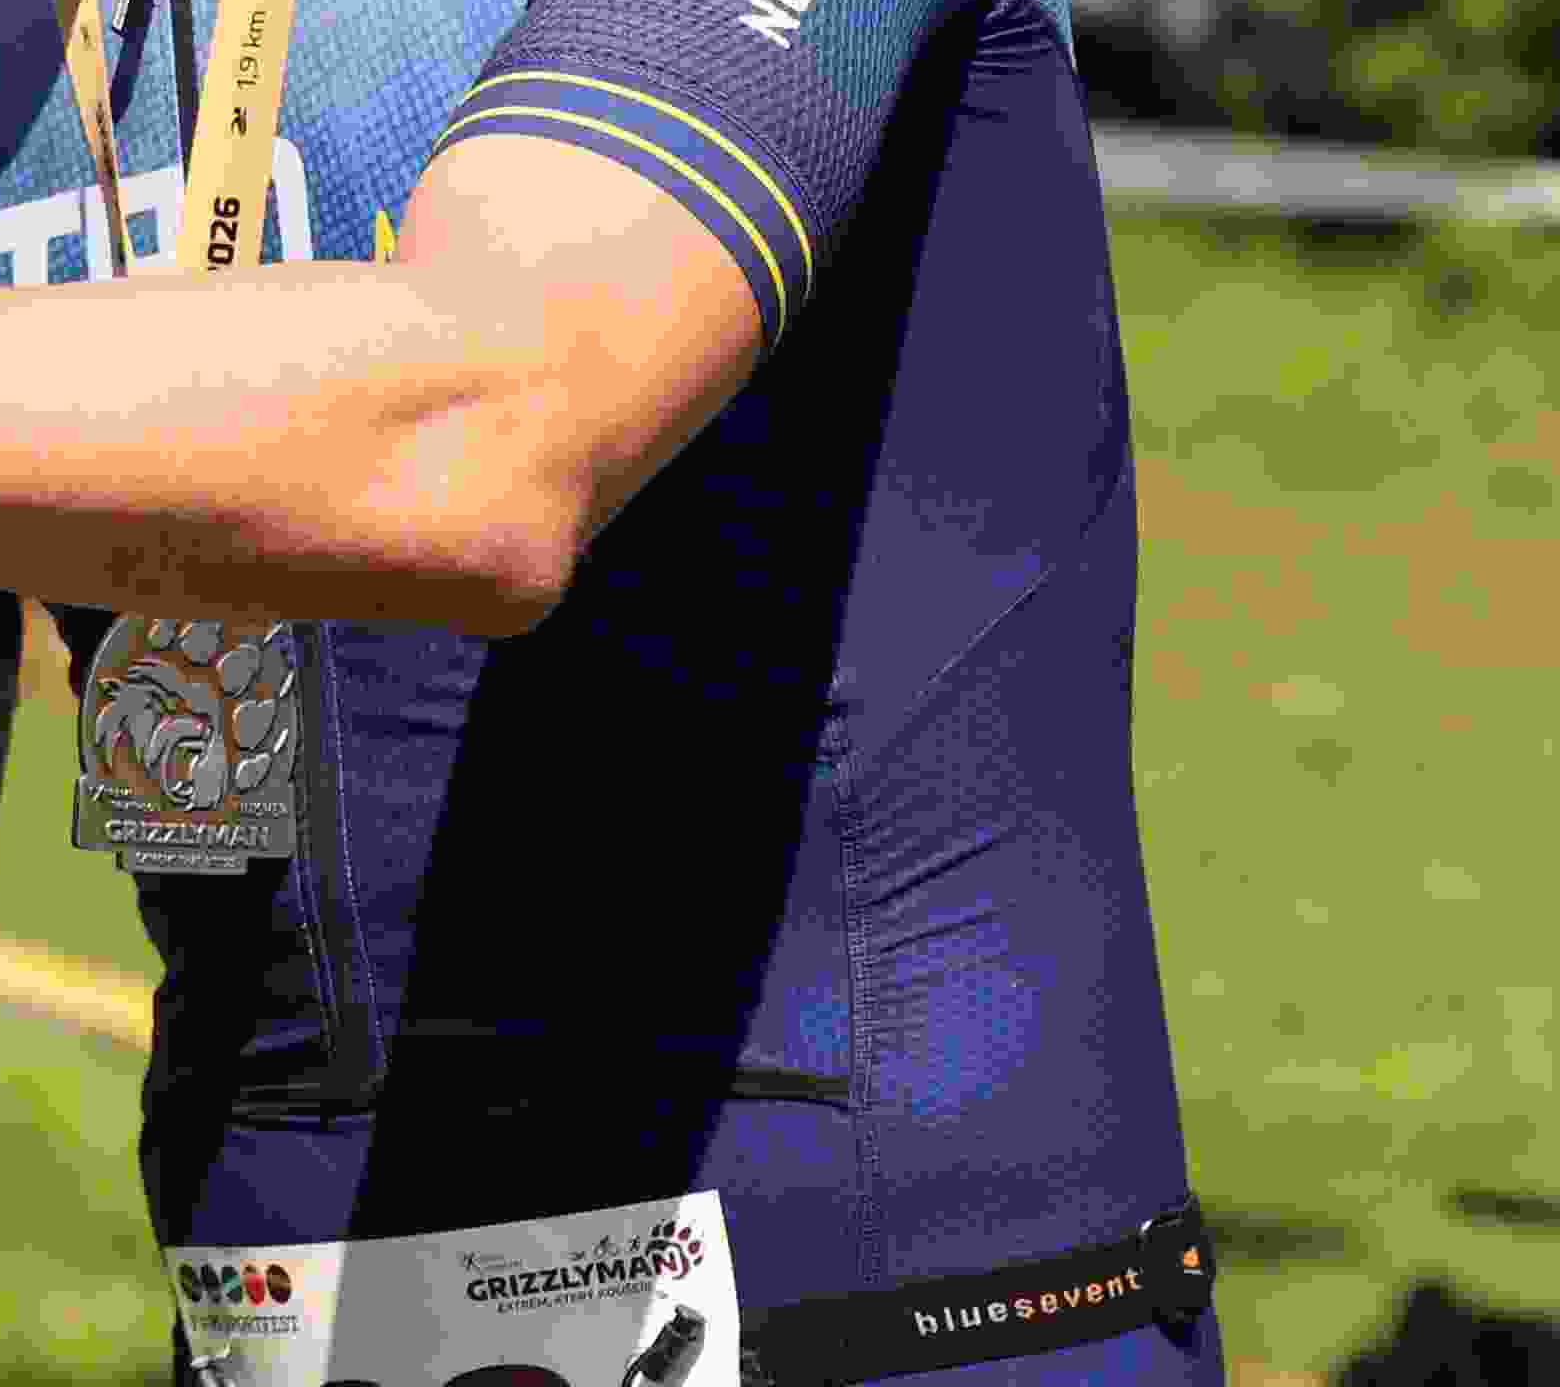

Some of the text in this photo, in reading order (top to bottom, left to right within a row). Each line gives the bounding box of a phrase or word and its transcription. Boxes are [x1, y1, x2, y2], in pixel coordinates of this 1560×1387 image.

[236, 10, 267, 91] 1,9 km
[207, 196, 241, 273] 026
[104, 819, 271, 849] GRIZZLYMAN
[466, 1251, 683, 1303] GRIZZLYMAN
[914, 1266, 1143, 1336] bluesevent
